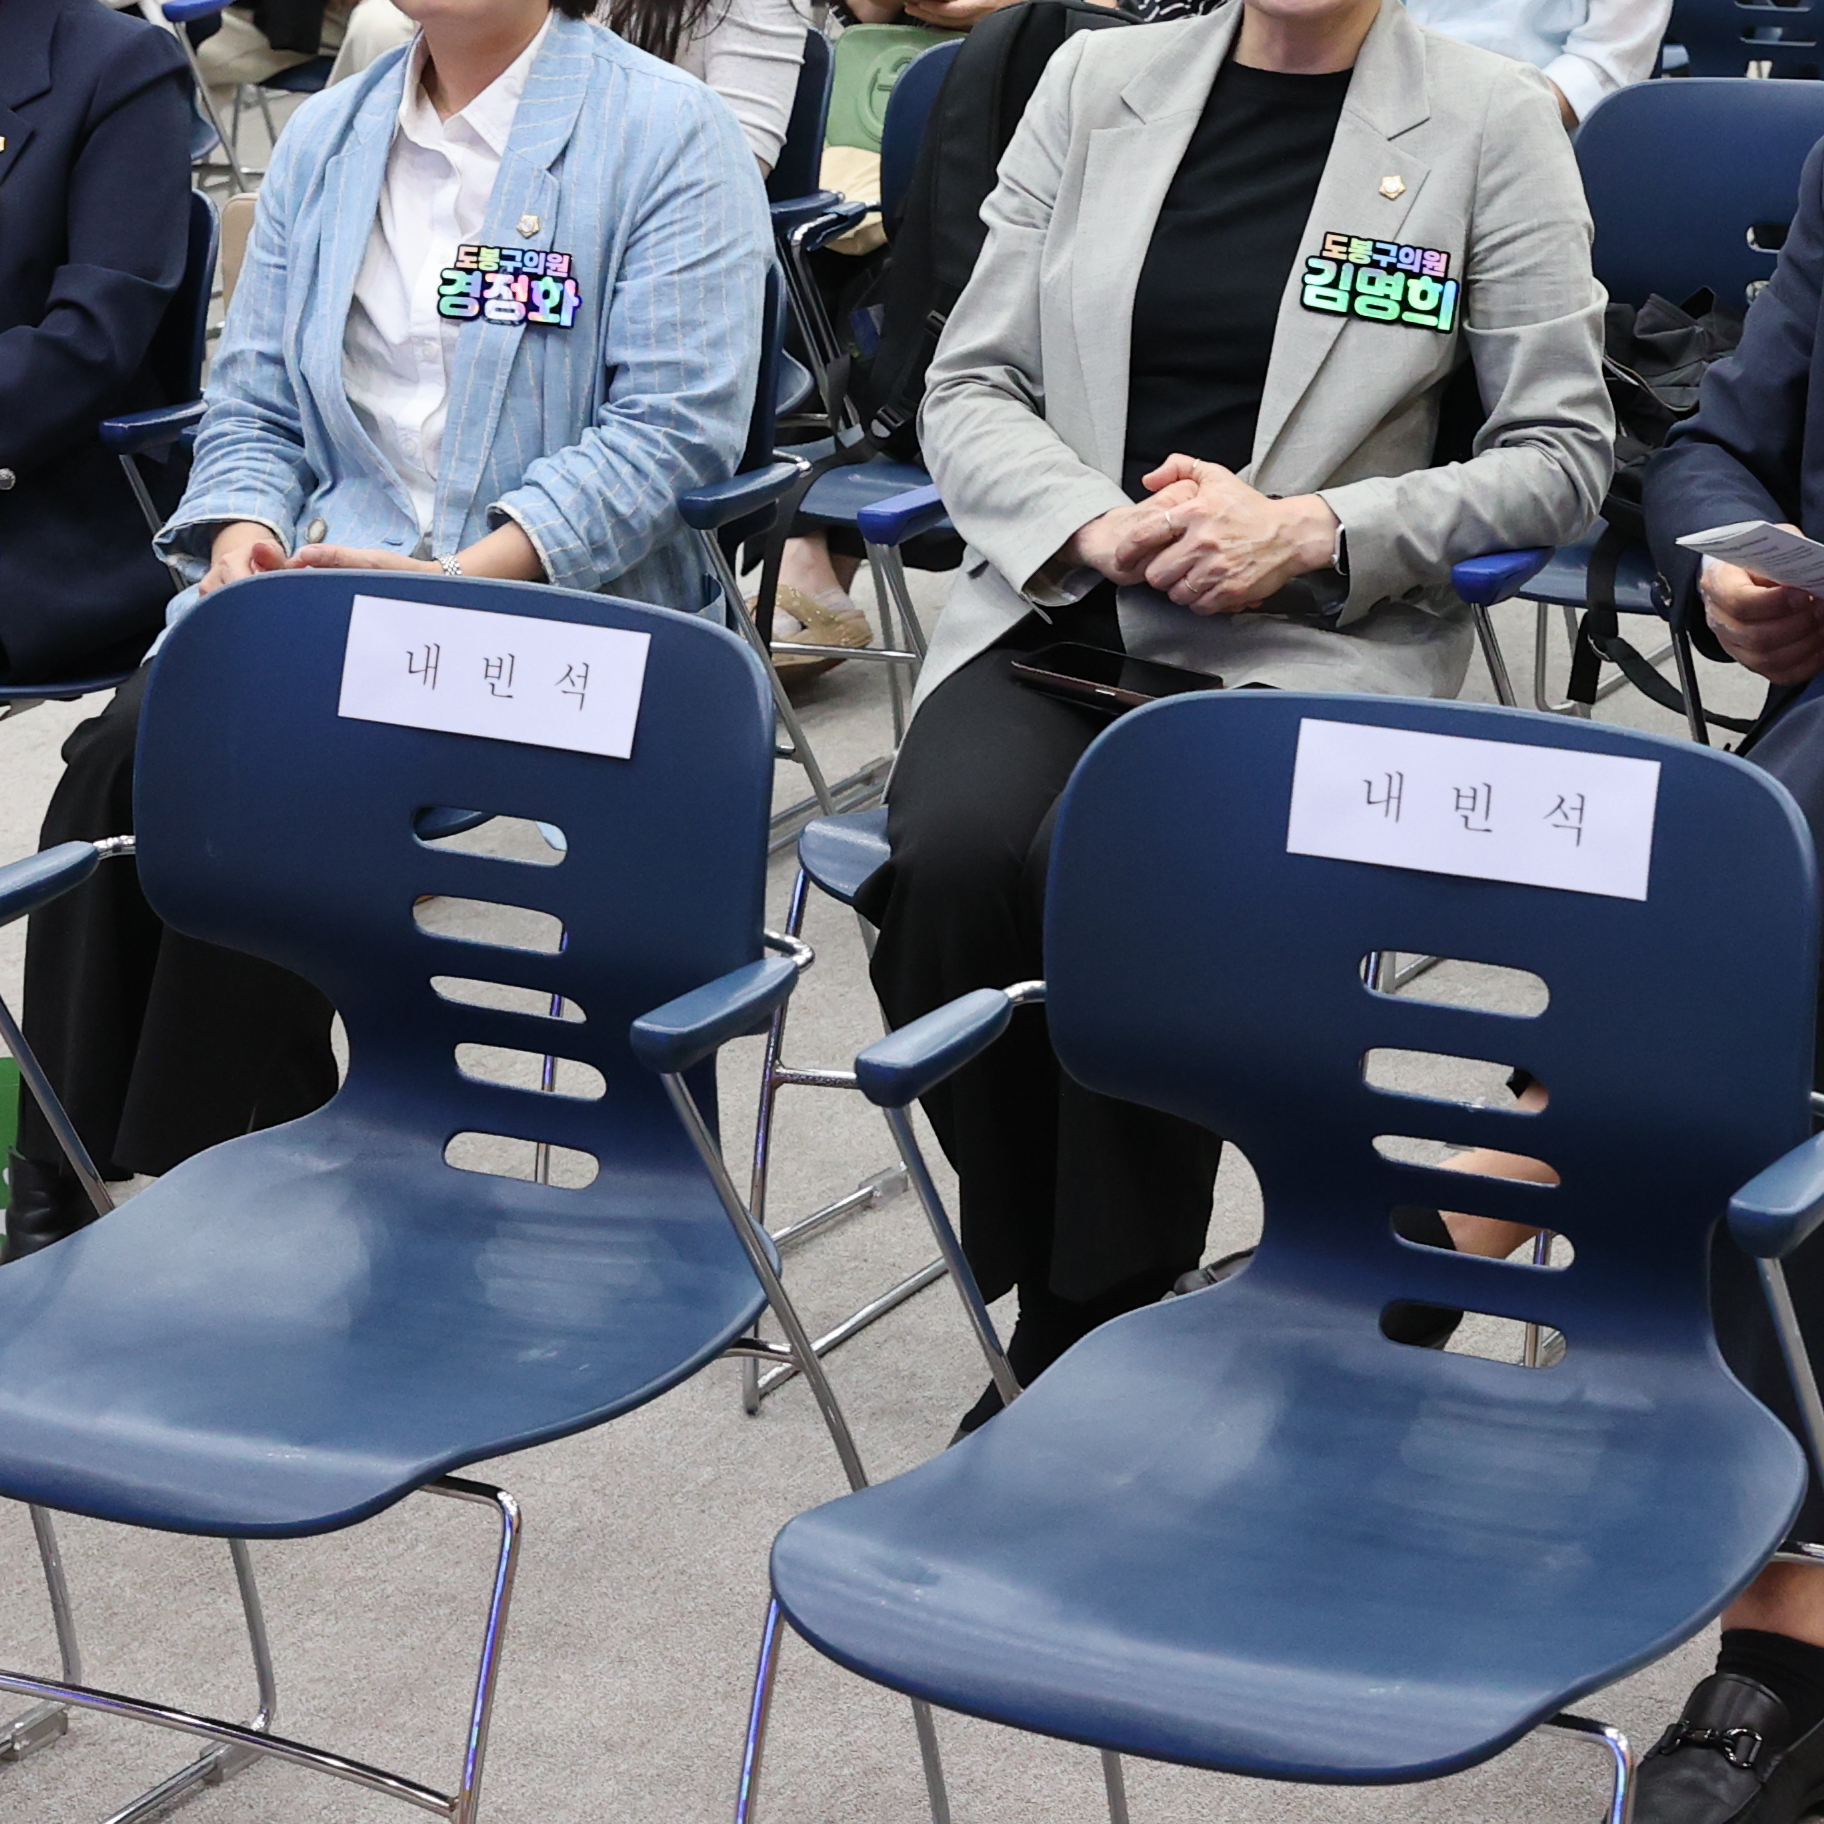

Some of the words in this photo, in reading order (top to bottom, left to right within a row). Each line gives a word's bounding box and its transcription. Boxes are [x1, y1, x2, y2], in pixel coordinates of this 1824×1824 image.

[456, 245, 570, 278] 도봉구의원
[1322, 233, 1448, 278] 도봉구의원
[1302, 257, 1457, 331] 김명희
[405, 642, 590, 711] 내빈석
[1363, 770, 1586, 848] 내빈석
